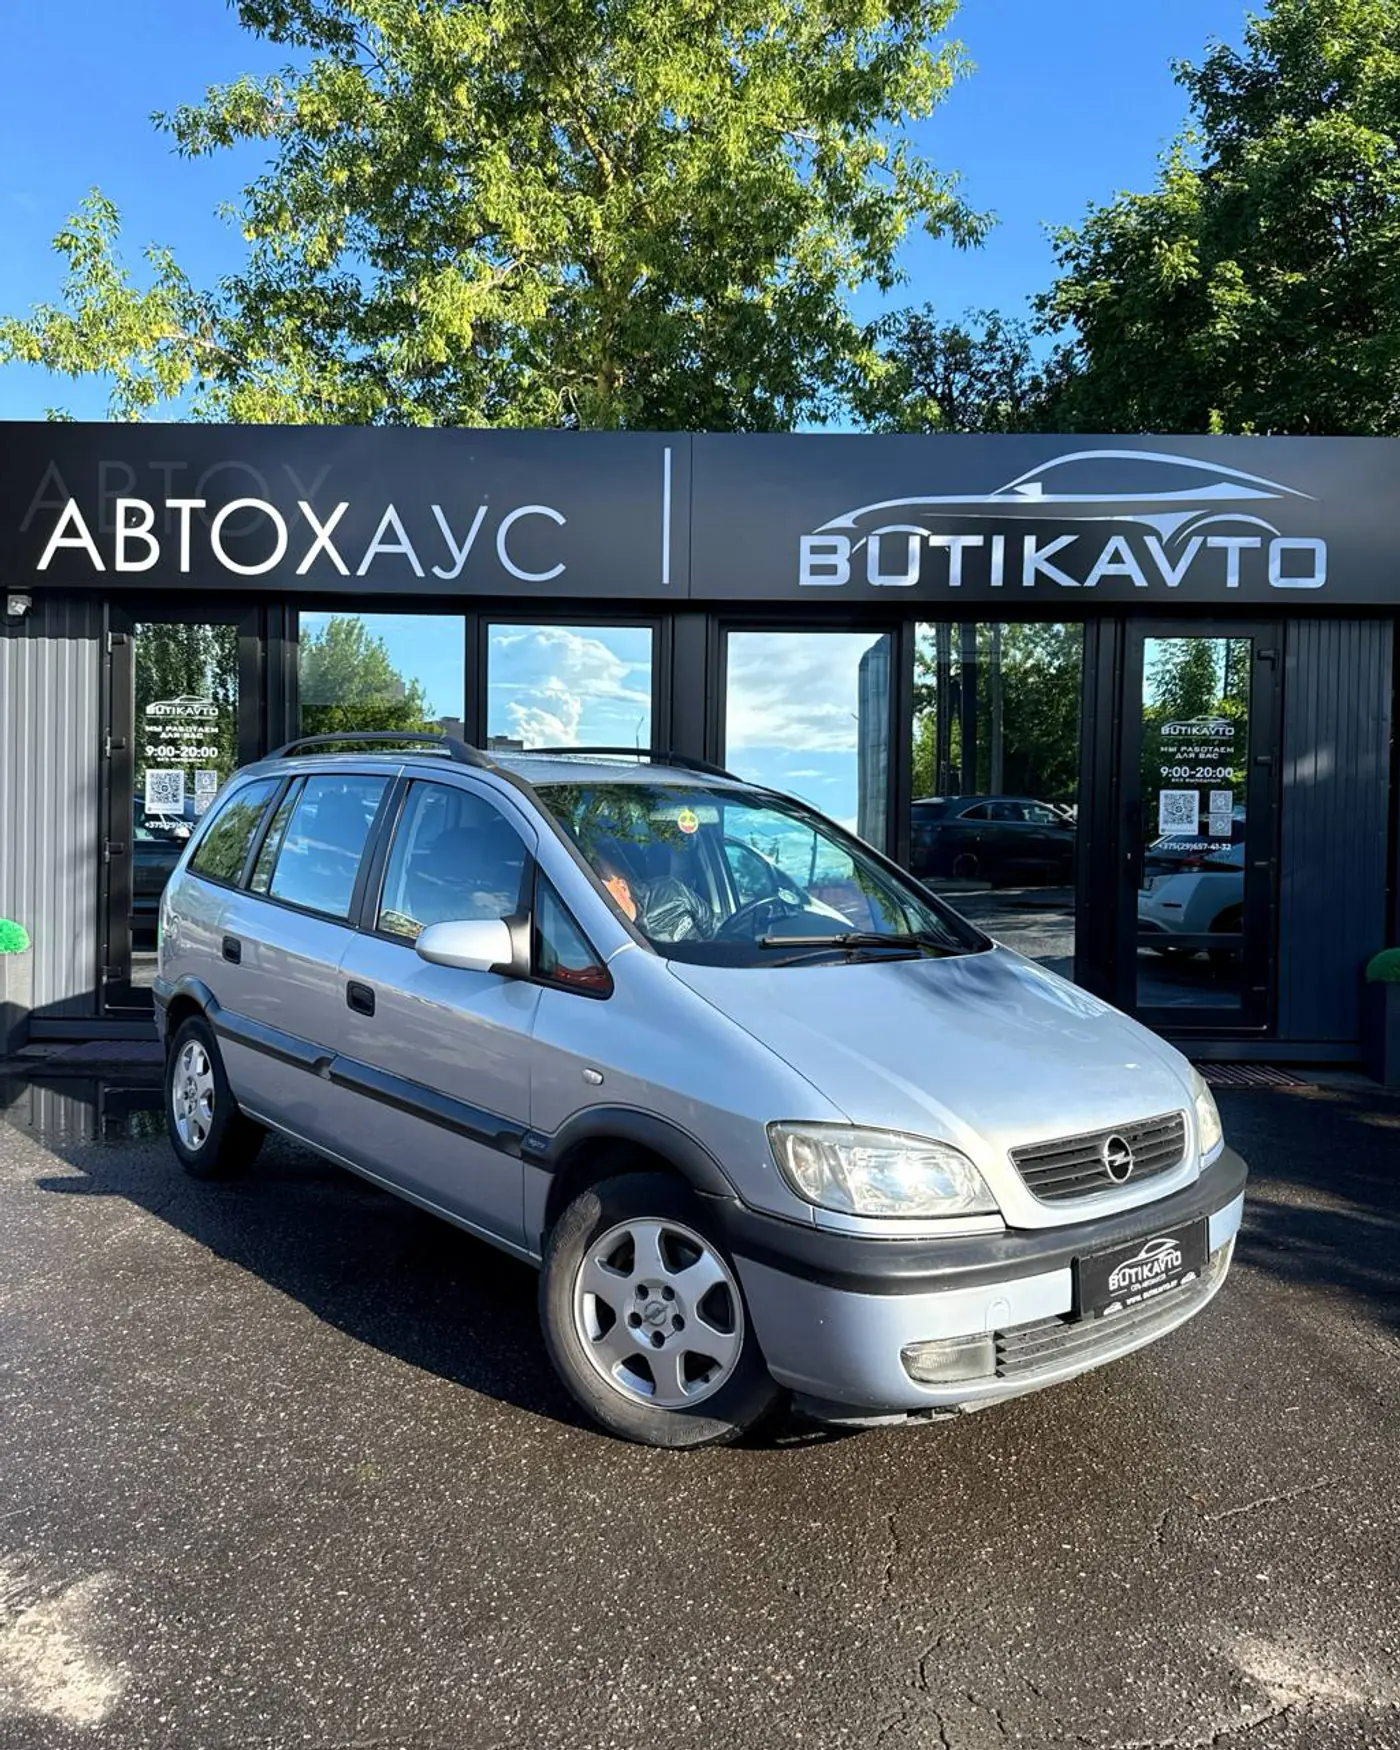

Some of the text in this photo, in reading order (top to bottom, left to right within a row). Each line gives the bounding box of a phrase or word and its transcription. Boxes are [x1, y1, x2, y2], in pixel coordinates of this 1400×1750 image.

[36, 497, 567, 582] АВТОХАУС
[798, 535, 1328, 589] BUTIKAVTO
[1160, 726, 1235, 736] BUTIKAVTO
[145, 745, 219, 758] 9:00-20:00
[1180, 745, 1235, 753] РАБОТАЕМ
[1160, 765, 1234, 778] 9:00-20:00
[1108, 1251, 1182, 1291] BUTIKAVTO
